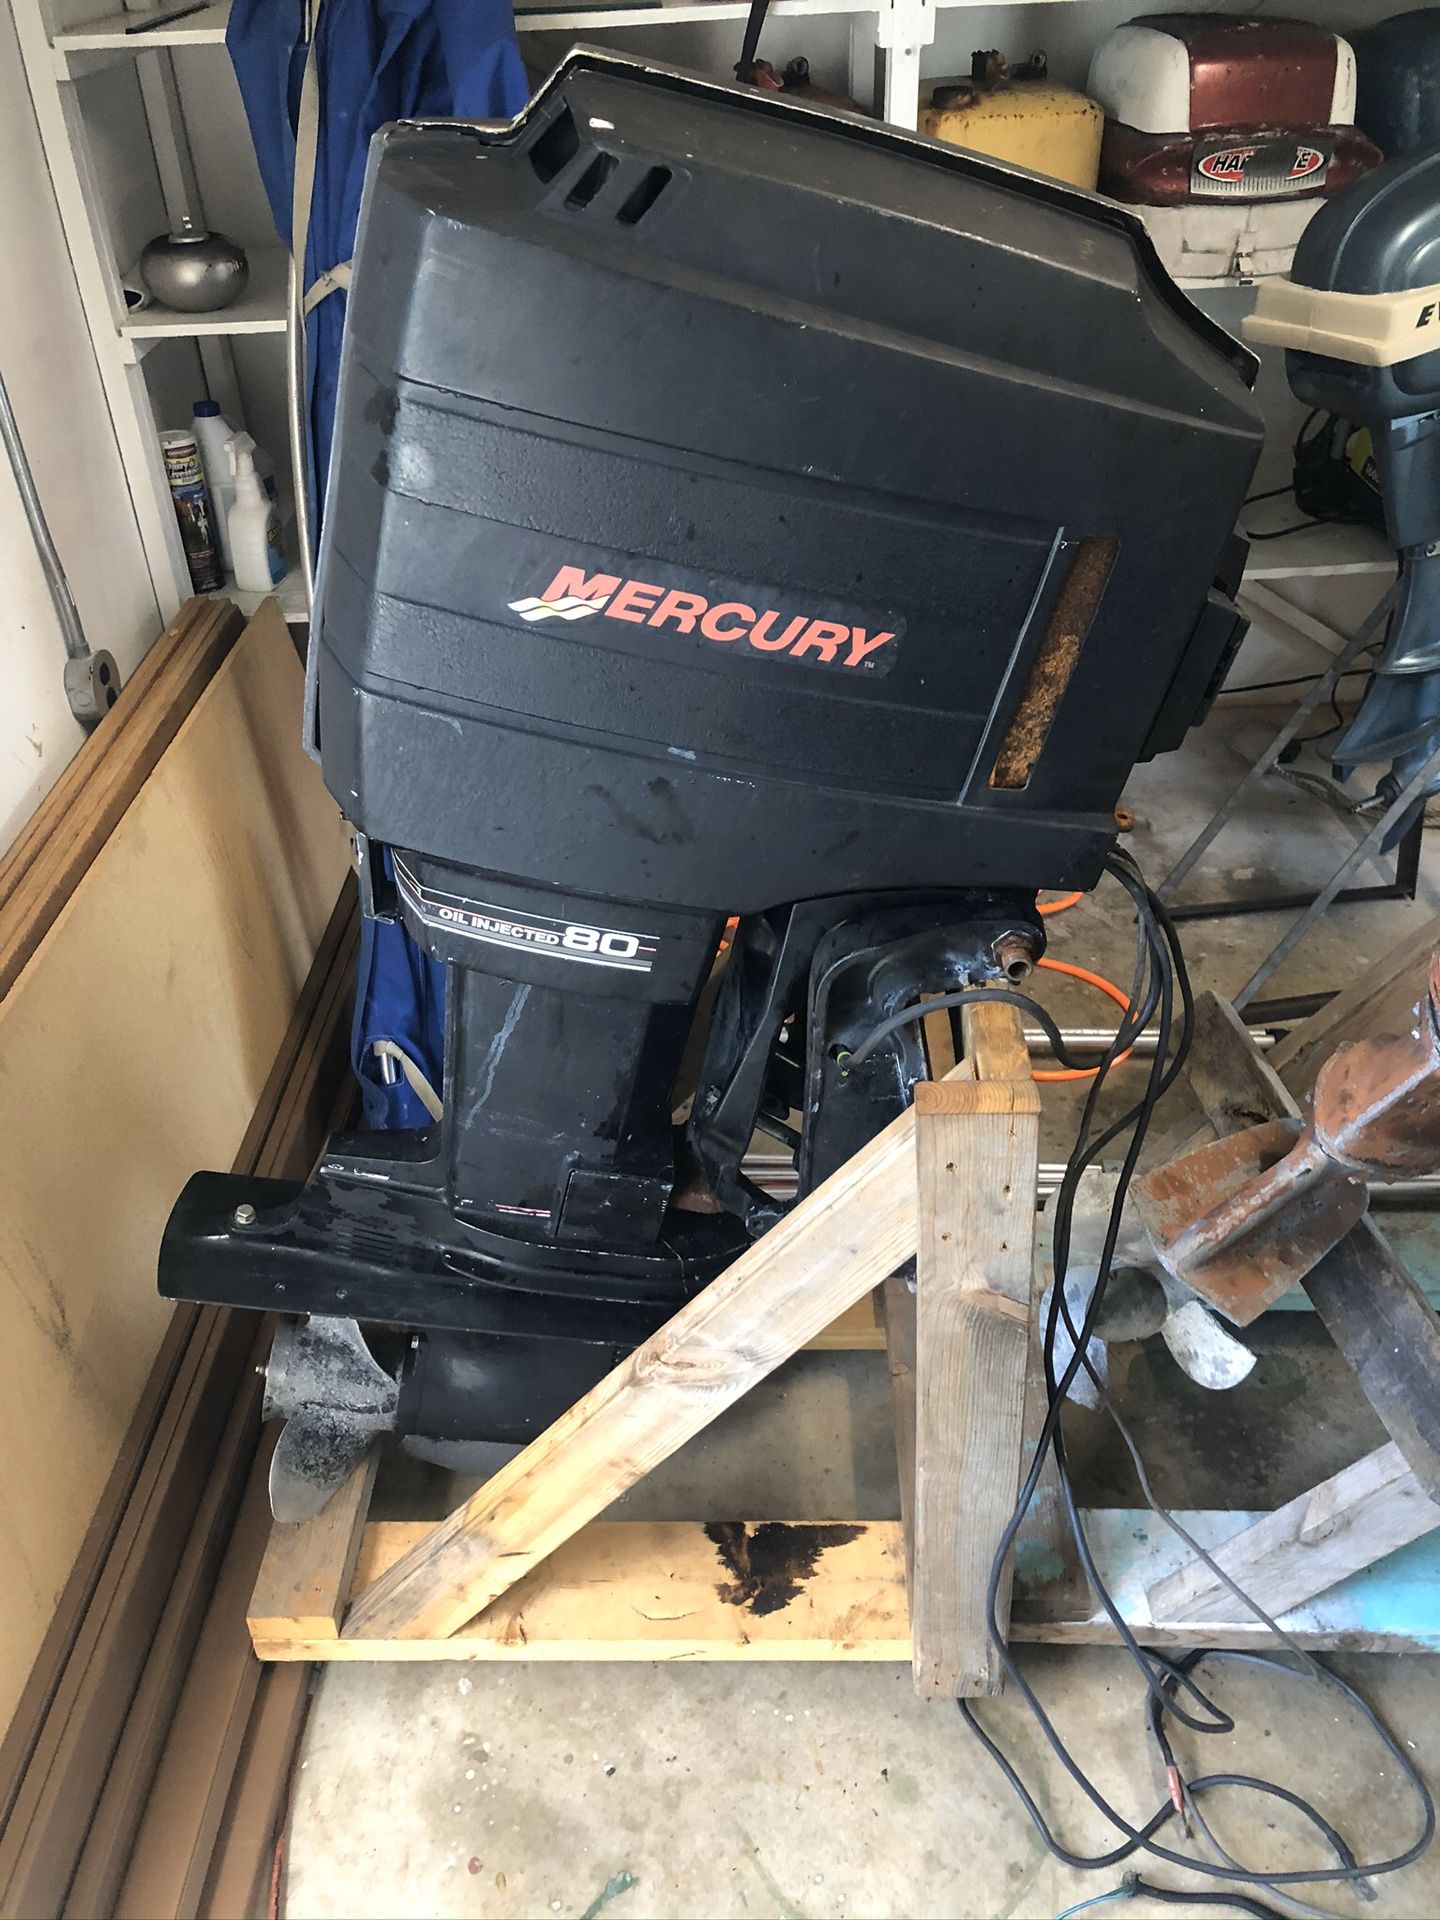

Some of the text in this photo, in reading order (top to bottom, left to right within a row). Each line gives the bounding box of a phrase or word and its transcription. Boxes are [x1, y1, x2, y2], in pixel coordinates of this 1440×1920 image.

[541, 565, 896, 667] MERCURY
[438, 908, 640, 958] OIL INJECTED 80
